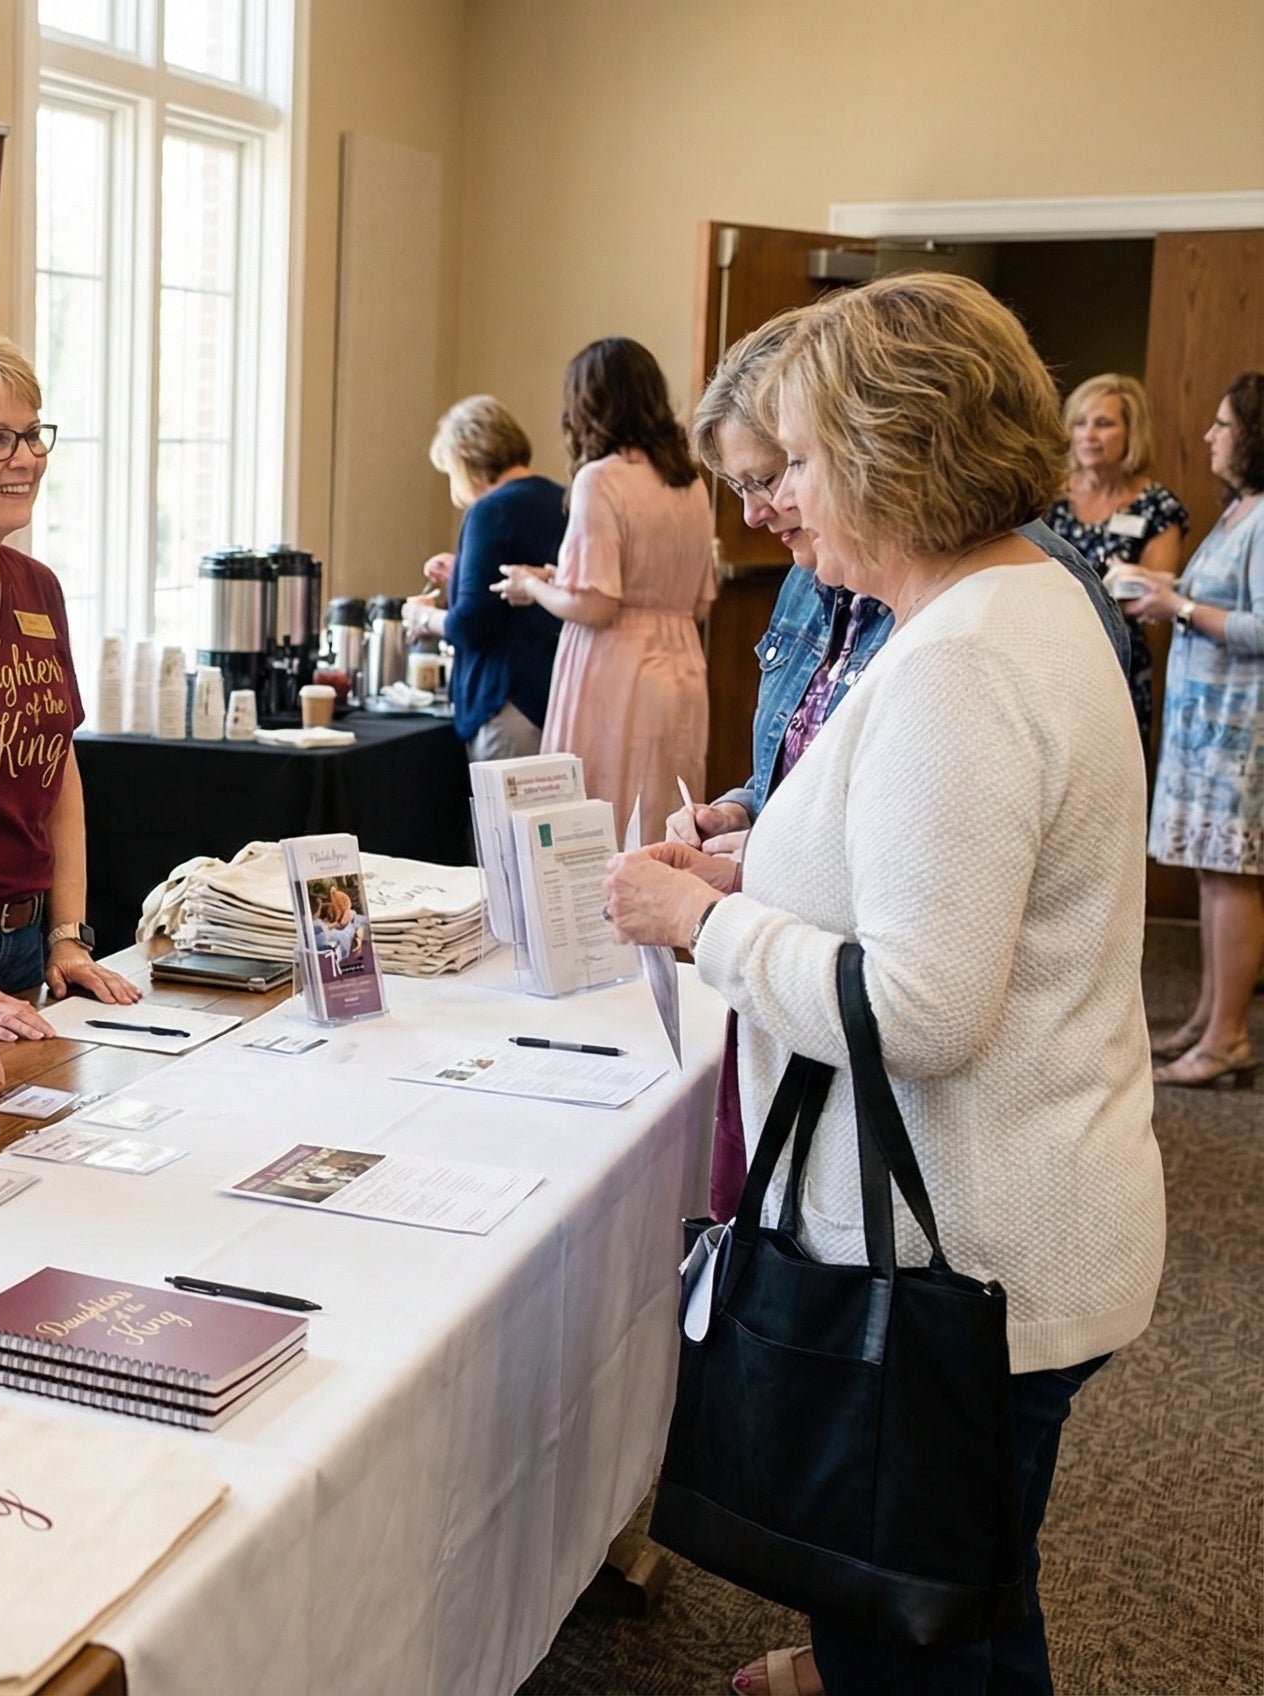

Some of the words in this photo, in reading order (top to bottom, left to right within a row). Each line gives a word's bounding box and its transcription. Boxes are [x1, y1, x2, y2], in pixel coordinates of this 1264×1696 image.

[25, 692, 41, 726] of
[44, 688, 67, 714] the
[106, 1310, 193, 1346] King
